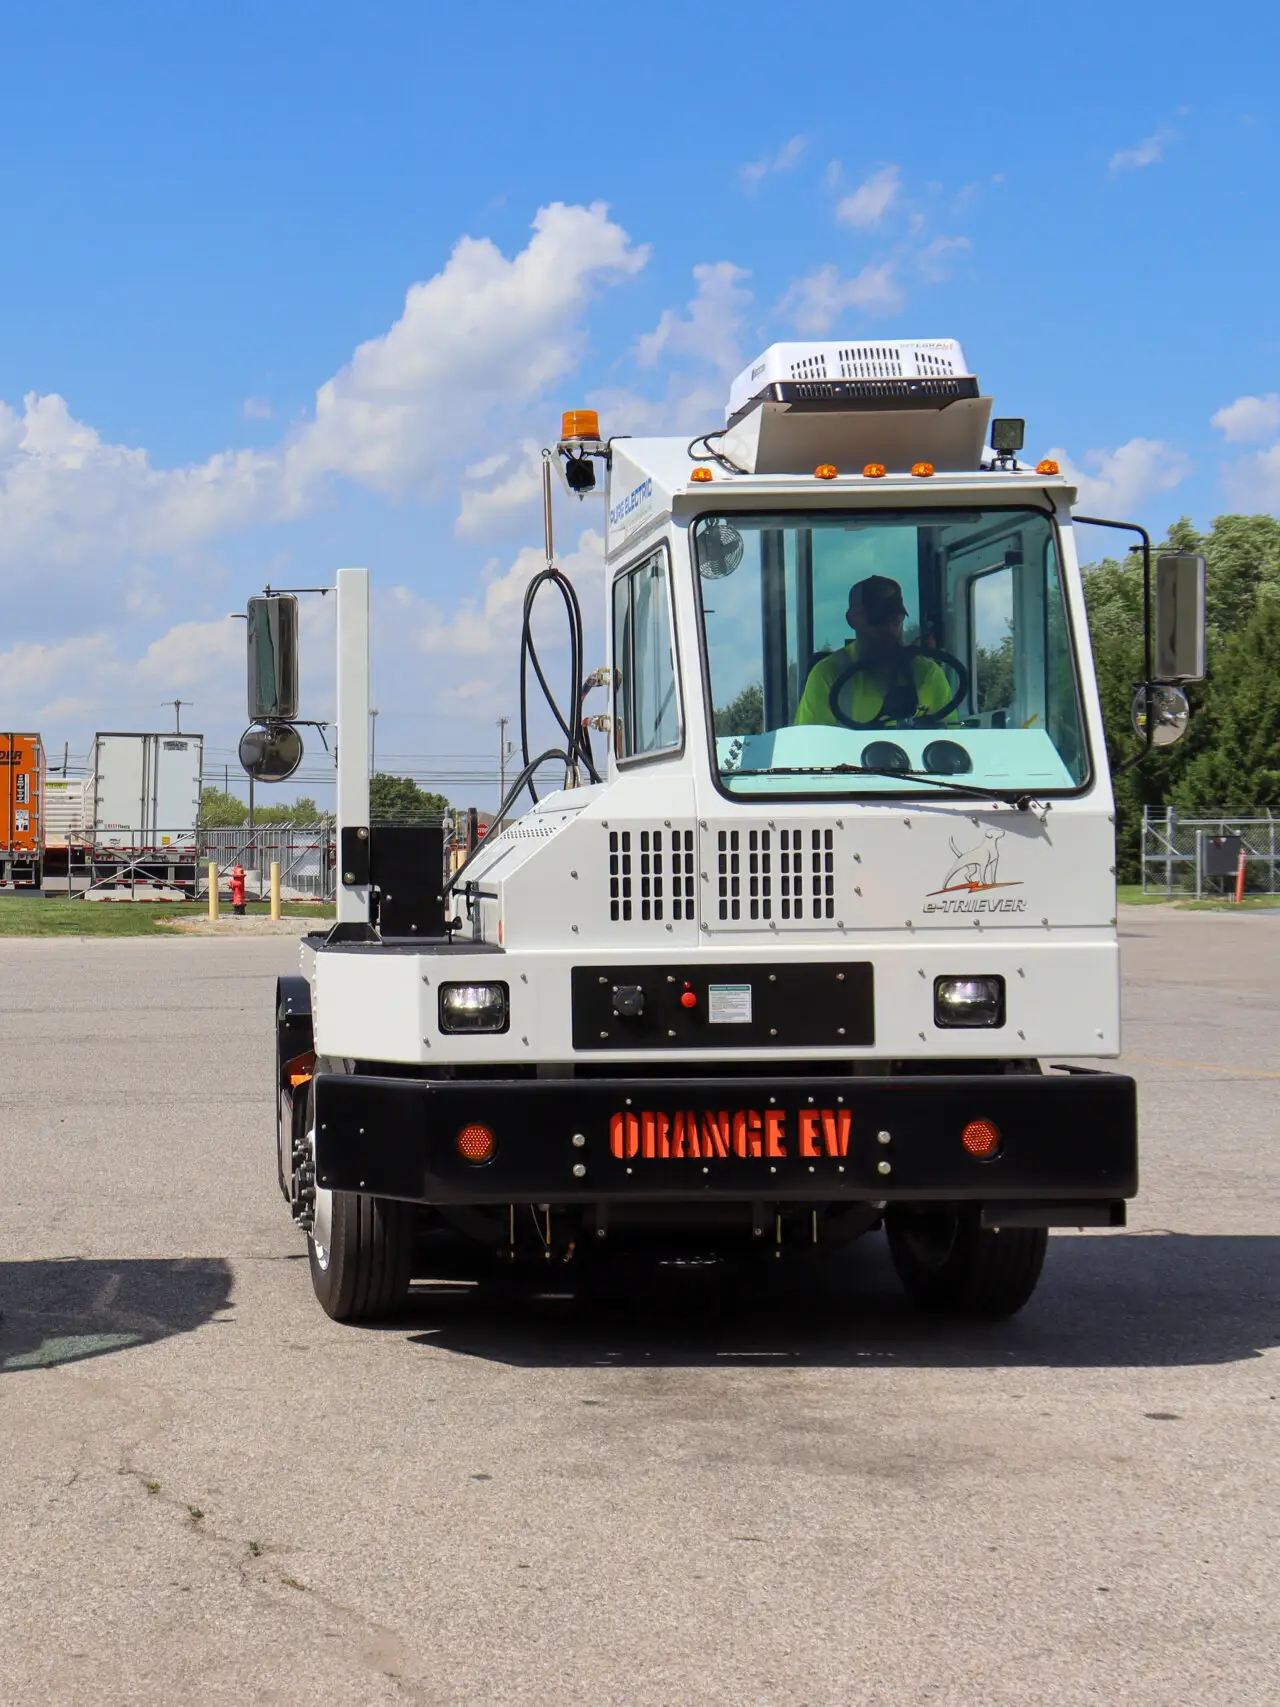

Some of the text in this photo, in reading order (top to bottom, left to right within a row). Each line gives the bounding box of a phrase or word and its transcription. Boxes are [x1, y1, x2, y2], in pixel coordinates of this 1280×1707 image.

[624, 477, 653, 516] ELECTRIC
[922, 899, 1029, 914] e-TRIEVER
[609, 1109, 852, 1159] ORANGE EV
